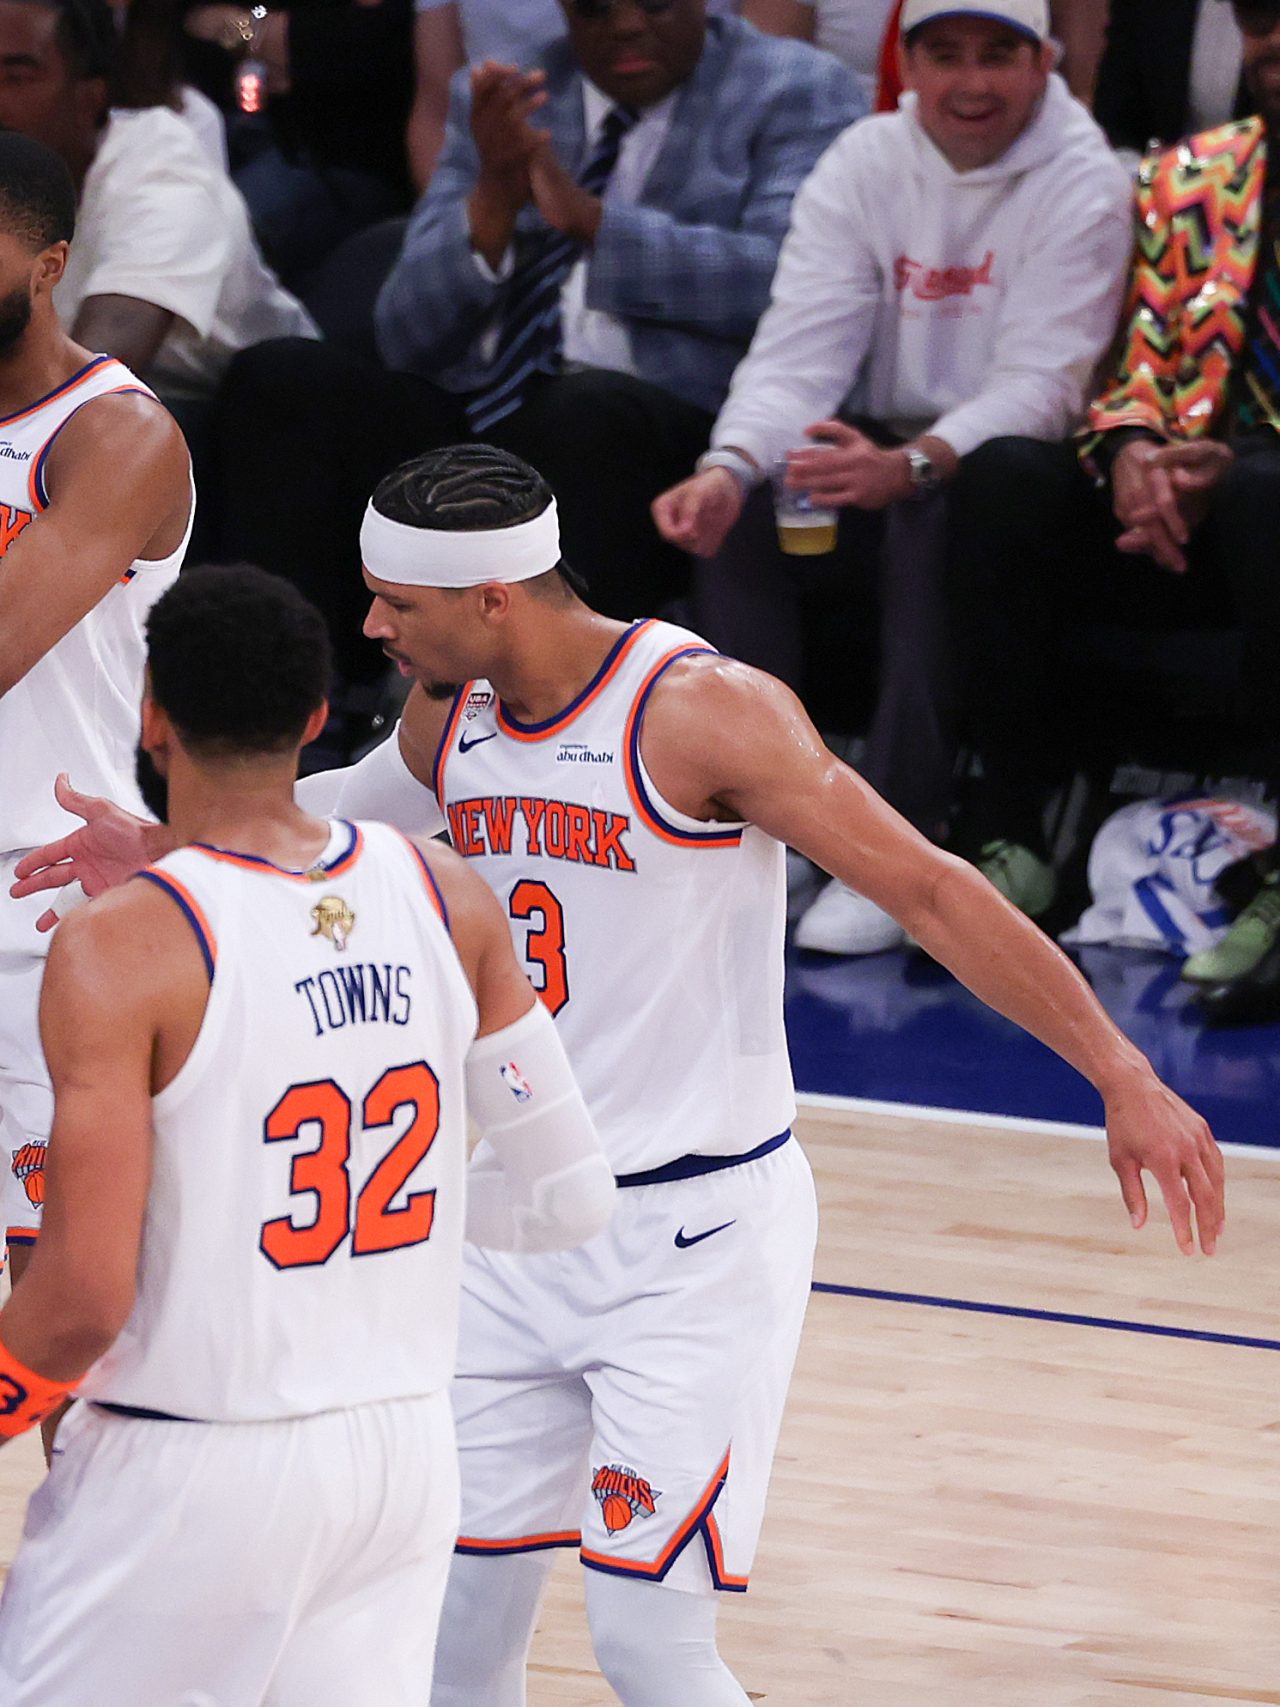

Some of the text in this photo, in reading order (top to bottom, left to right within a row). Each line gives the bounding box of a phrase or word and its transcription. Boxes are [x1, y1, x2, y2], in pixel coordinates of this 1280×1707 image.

[556, 751, 614, 763] abu dhabi
[447, 797, 638, 873] NEW YORK
[509, 879, 570, 1018] 3
[294, 963, 412, 1037] TOWNS
[259, 1060, 440, 1271] 32
[591, 1465, 656, 1513] KNICKS
